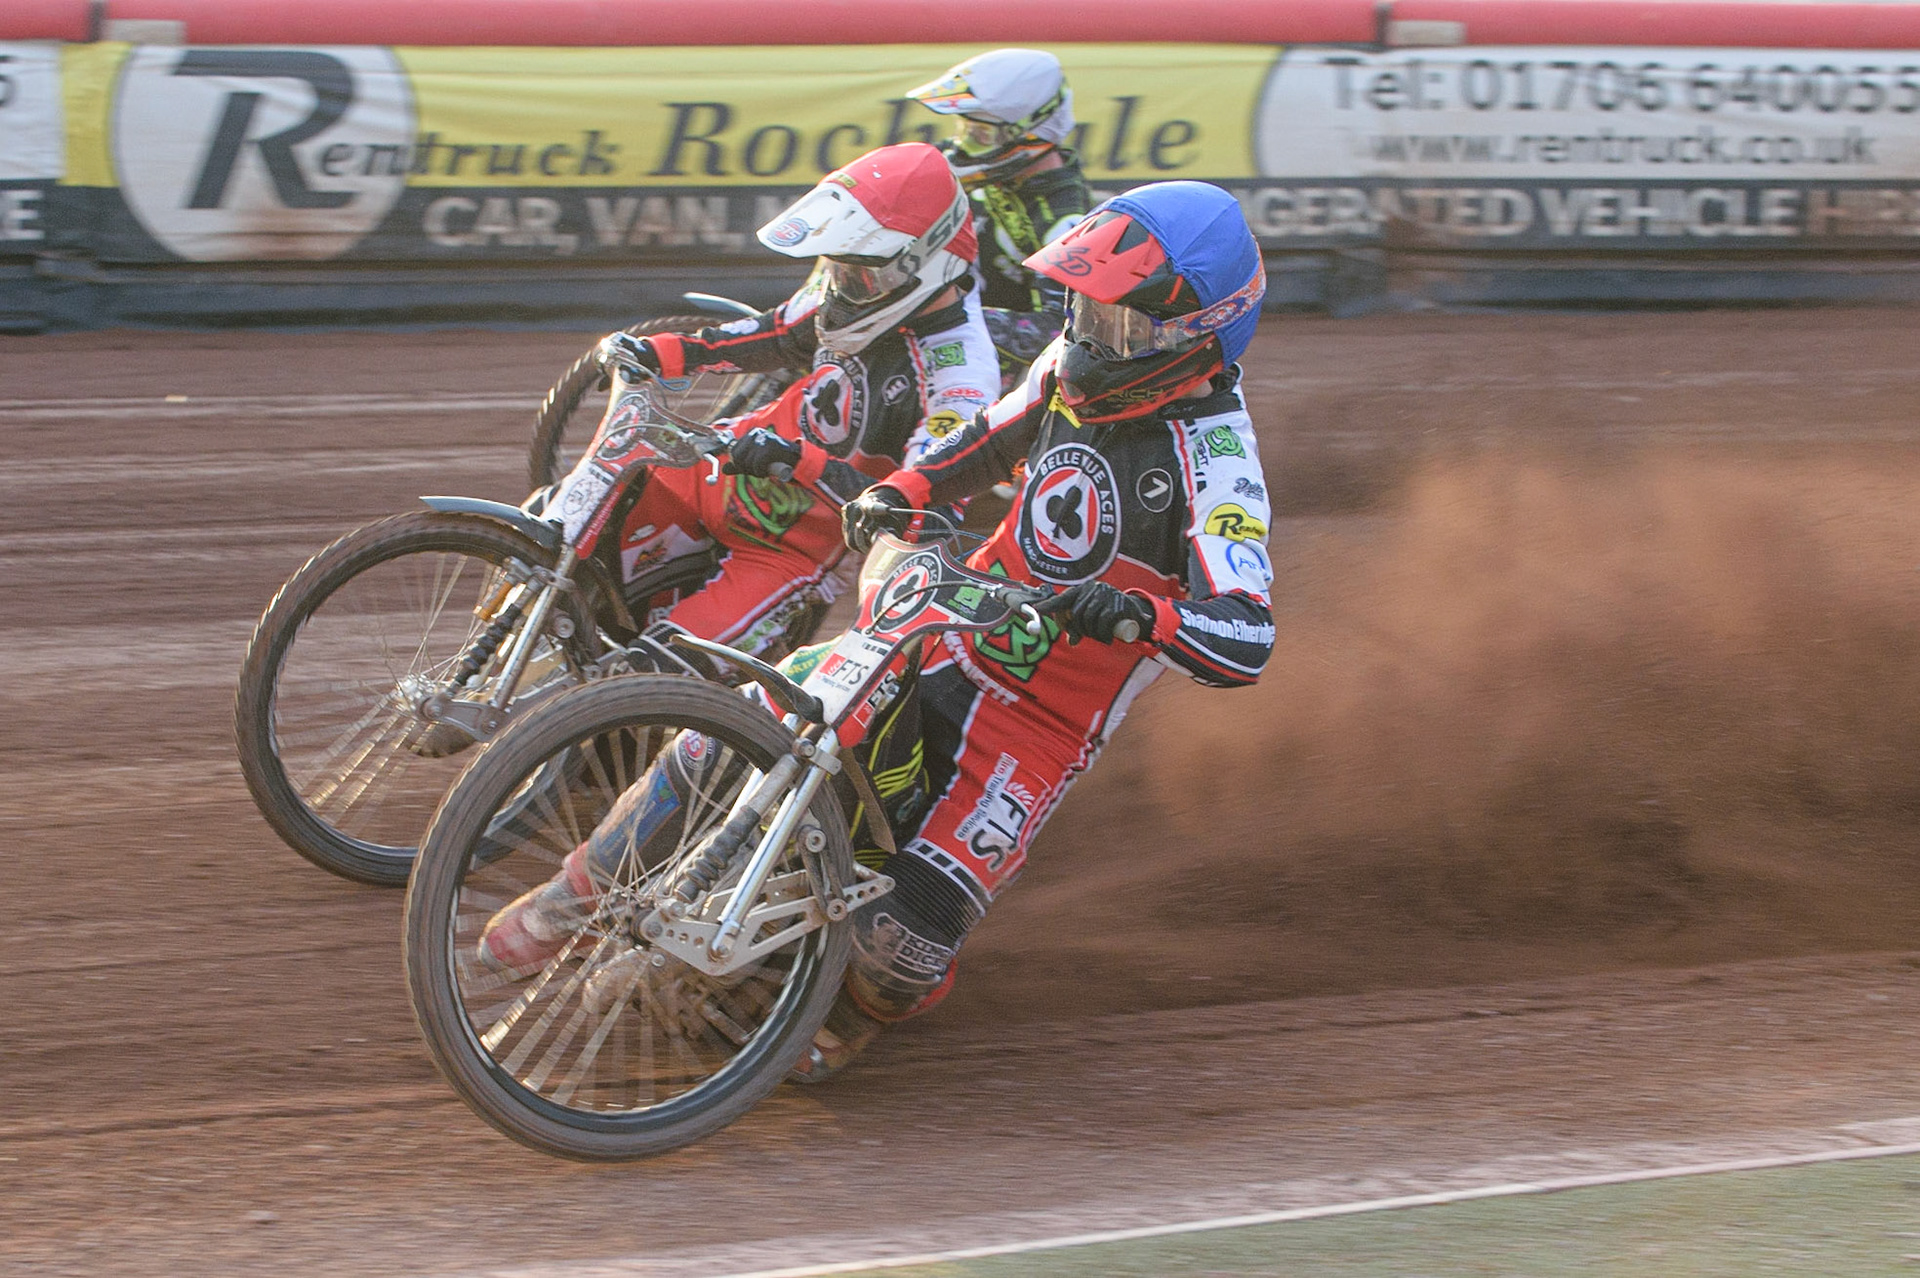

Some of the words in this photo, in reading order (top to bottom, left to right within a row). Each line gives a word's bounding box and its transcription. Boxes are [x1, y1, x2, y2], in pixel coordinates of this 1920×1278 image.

[1321, 55, 1444, 110] Tel:
[1460, 58, 1666, 112] 01706
[172, 50, 622, 209] Rentruck
[643, 96, 1200, 176] Rochle
[421, 195, 579, 255] CAR,
[587, 195, 746, 254] VAN,
[1540, 187, 1800, 236] VEHICLE
[1099, 489, 1115, 535] ACES
[1023, 537, 1068, 574] MANCESTER
[971, 792, 1028, 870] FTS
